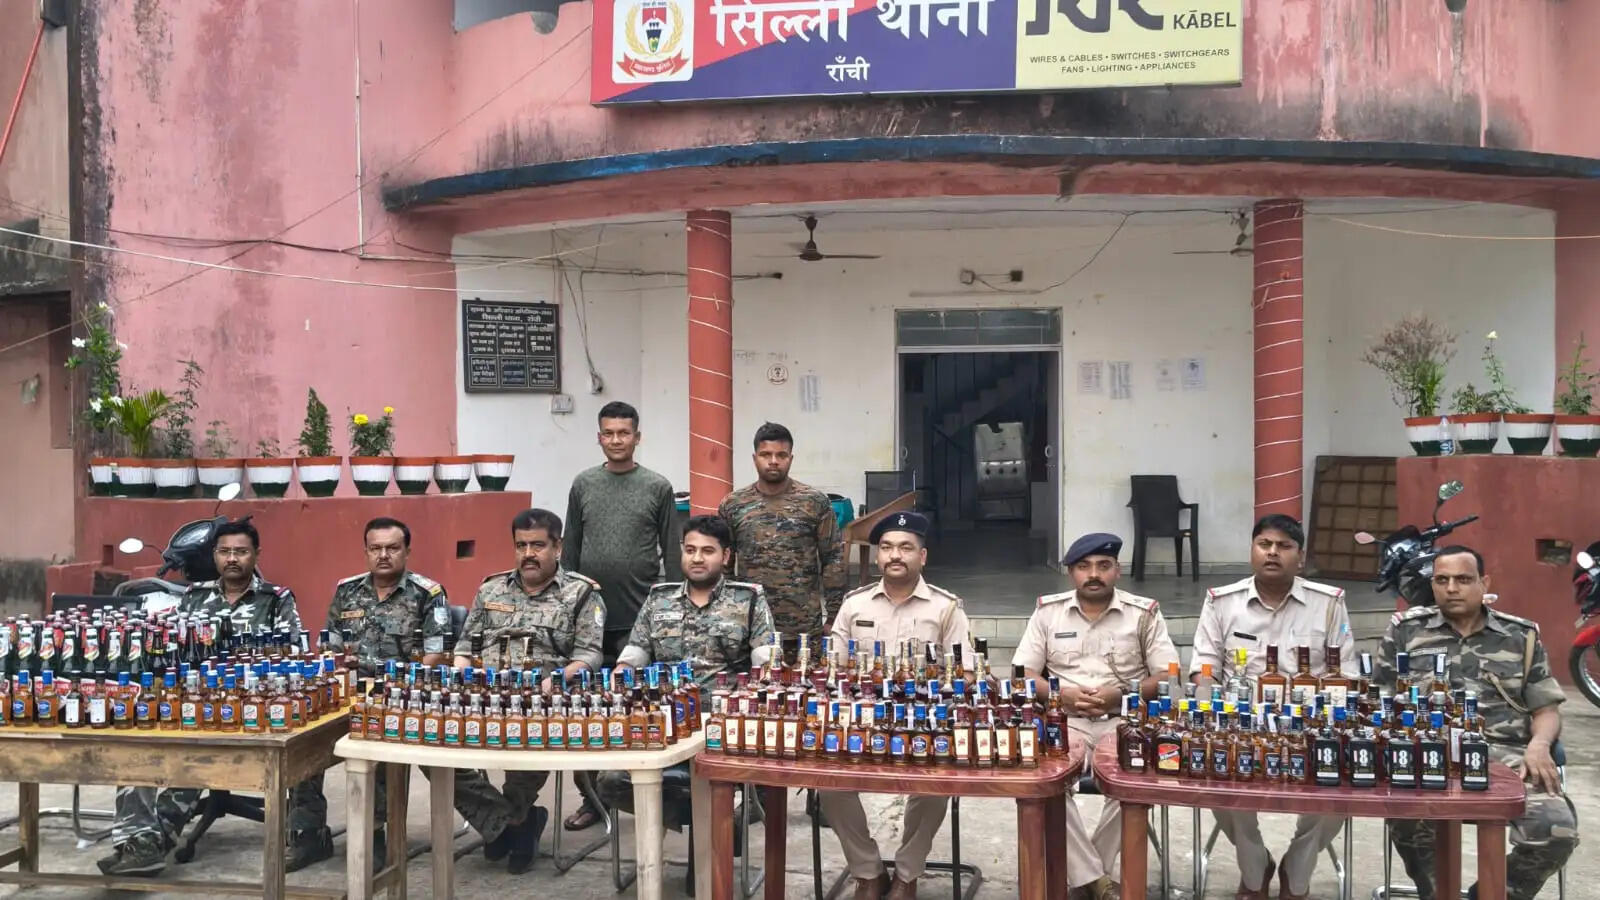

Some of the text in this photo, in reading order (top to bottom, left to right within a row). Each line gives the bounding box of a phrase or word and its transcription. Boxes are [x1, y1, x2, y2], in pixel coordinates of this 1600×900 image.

[876, 0, 995, 40] थाना
[1030, 55, 1058, 64] WIRES
[1068, 53, 1104, 62] CABLES
[1111, 51, 1156, 61] SWITCHES
[1164, 48, 1230, 59] SWITCHGEARS
[826, 56, 871, 82] राँची
[1061, 61, 1197, 73] FANS LIGHTING APPLIANCES
